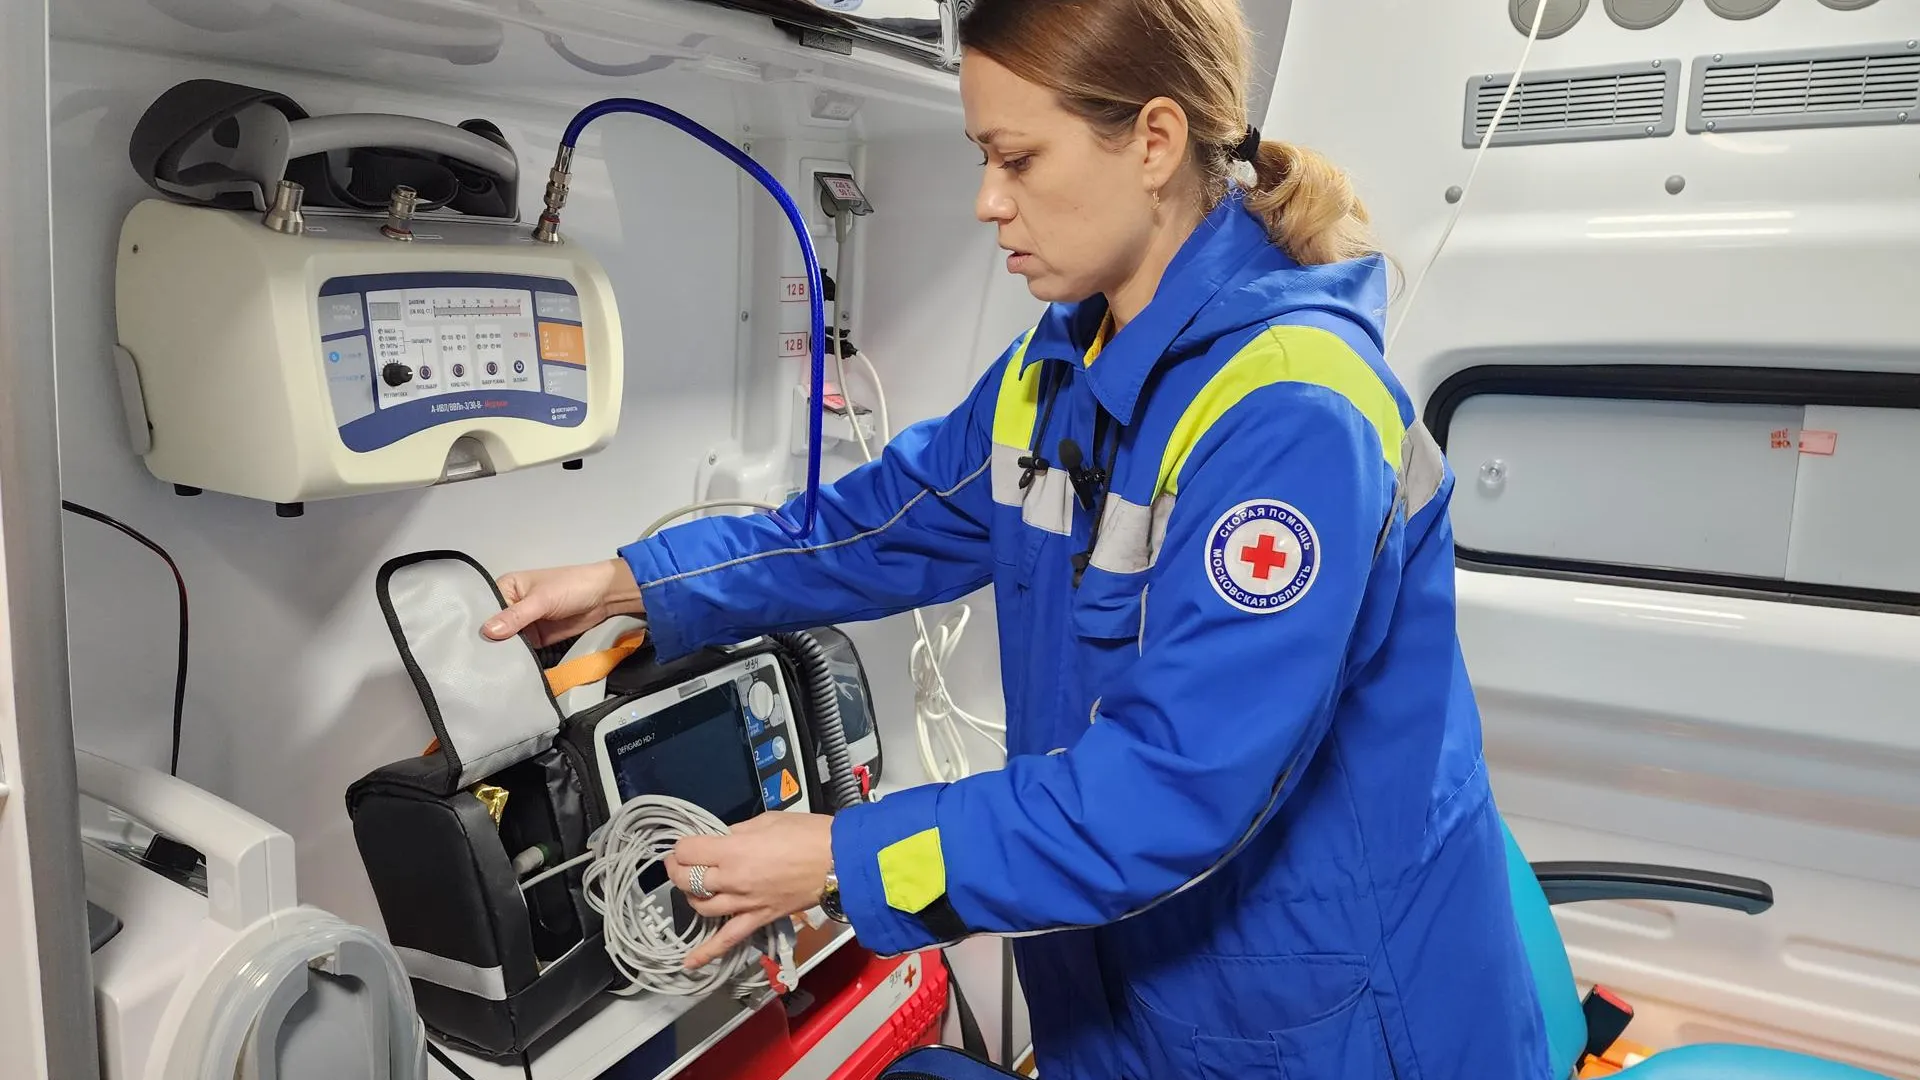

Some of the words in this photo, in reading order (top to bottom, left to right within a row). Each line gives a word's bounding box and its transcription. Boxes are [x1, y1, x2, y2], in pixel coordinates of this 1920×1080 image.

[787, 284, 797, 296] 12
[798, 284, 805, 295] В
[785, 340, 795, 351] 12
[796, 338, 803, 350] В
[1220, 507, 1265, 538] СКОРАЯ
[1269, 508, 1311, 551] ПОМОЩЬ
[1213, 548, 1267, 607] МОСКОВСКАЯ
[1270, 565, 1311, 606] ОБЛАСТЬ
[617, 738, 643, 755] DEFIGARD
[643, 732, 655, 744] HD-7
[754, 750, 760, 761] 2
[763, 787, 769, 798] 3
